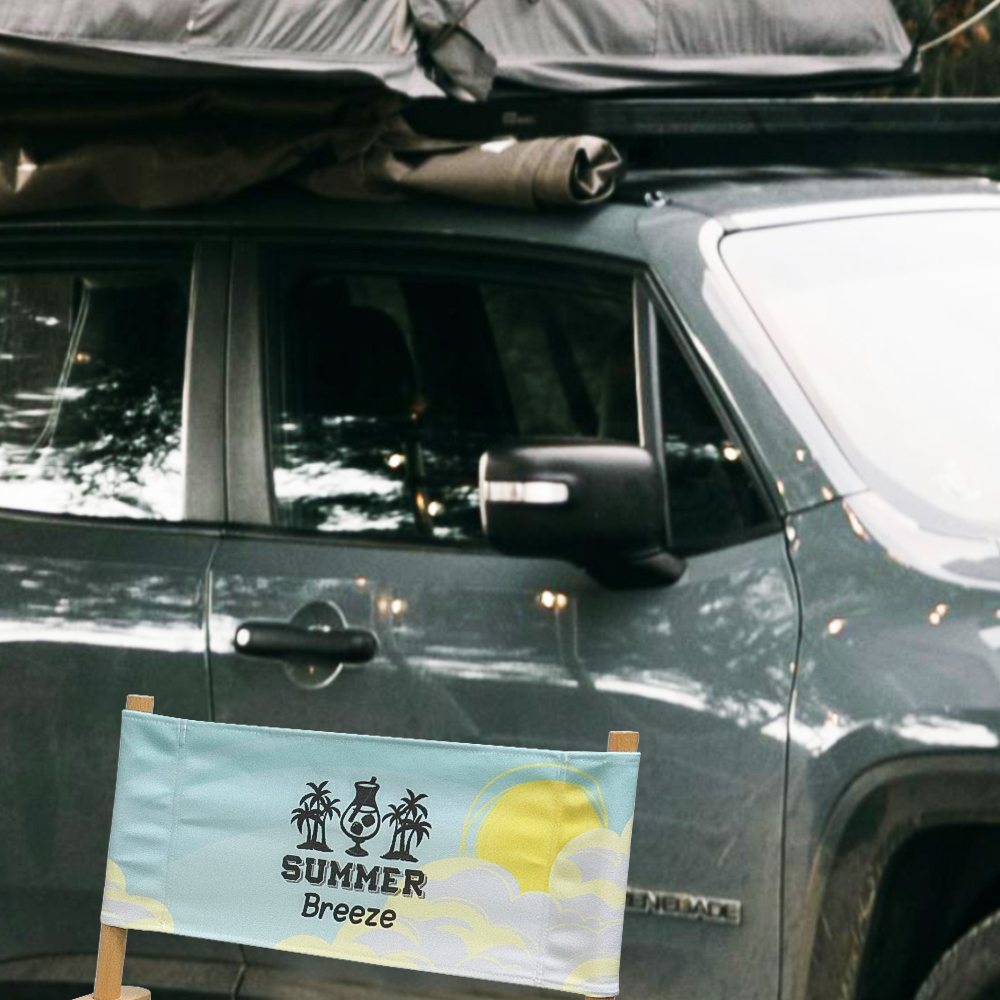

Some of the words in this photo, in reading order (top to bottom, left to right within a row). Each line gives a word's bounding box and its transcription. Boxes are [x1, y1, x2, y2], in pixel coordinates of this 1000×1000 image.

[281, 854, 428, 899] SUMMER
[301, 892, 397, 929] Breeze
[626, 886, 741, 926] ENEGADE
